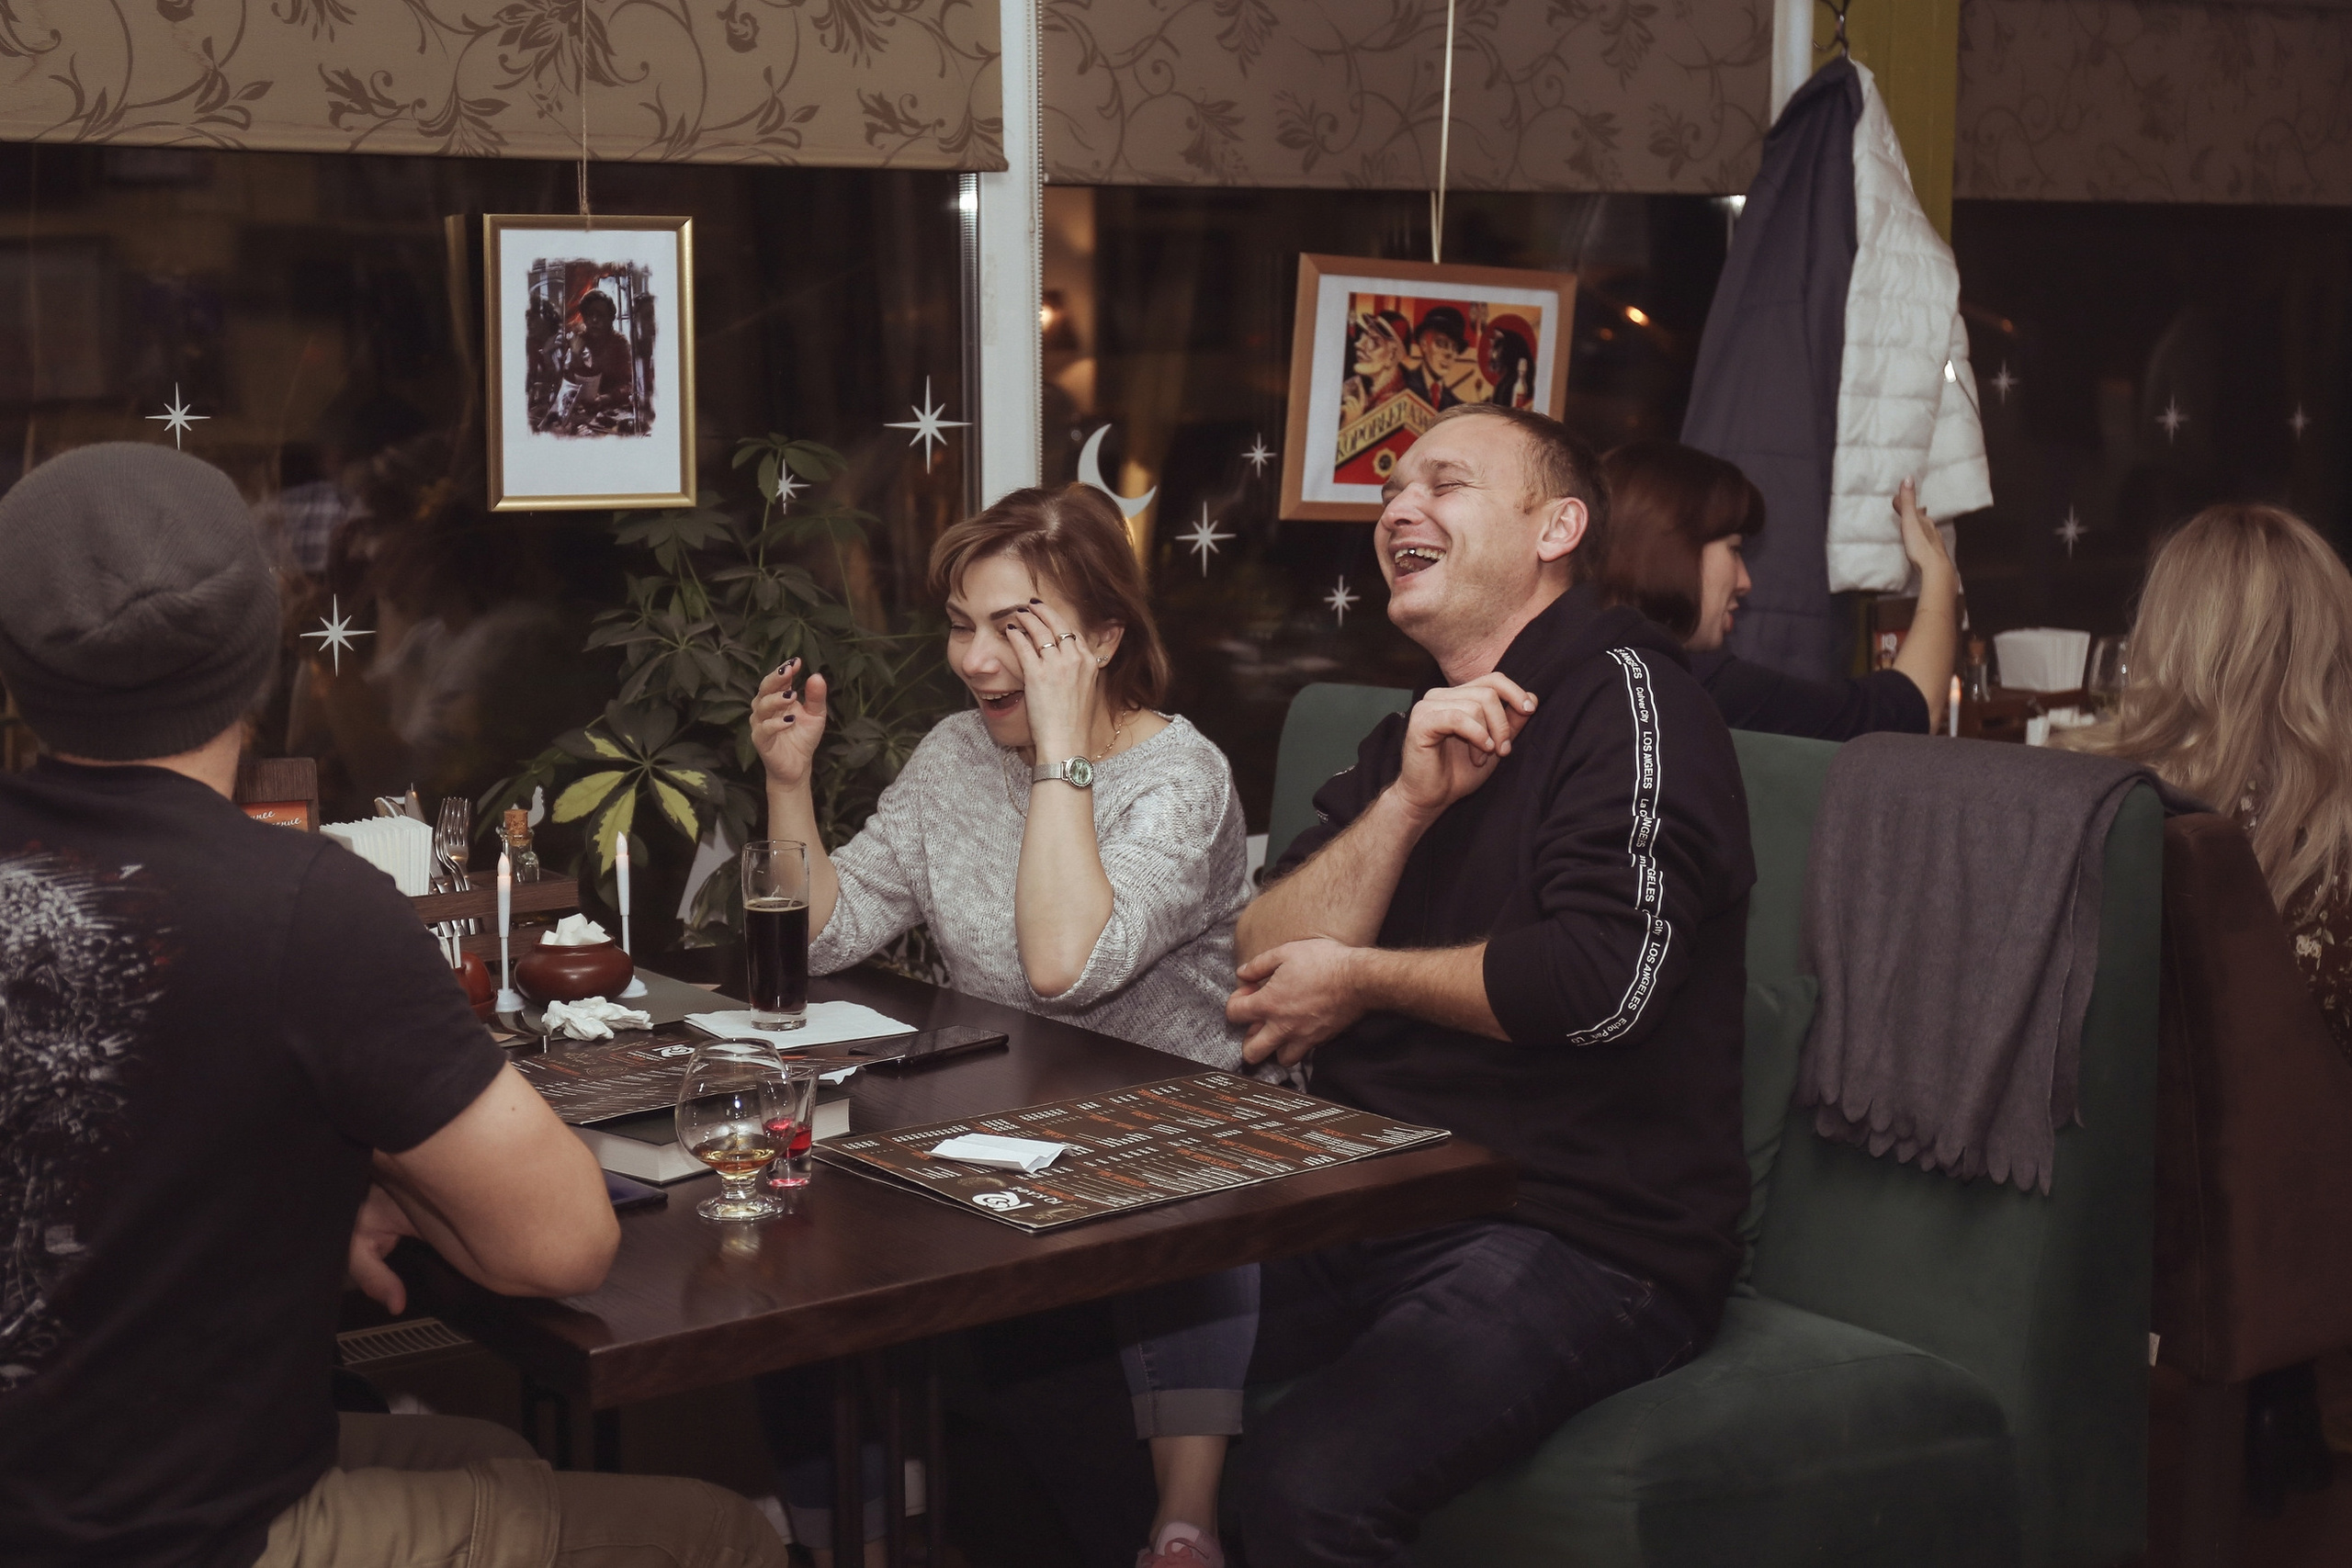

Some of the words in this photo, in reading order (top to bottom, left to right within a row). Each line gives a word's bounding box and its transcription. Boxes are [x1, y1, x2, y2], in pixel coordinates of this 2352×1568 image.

[1635, 686, 1645, 710] Culver
[1640, 709, 1649, 723] City
[1643, 730, 1653, 752] LOS
[1643, 752, 1654, 790] ANGELES
[1646, 942, 1661, 964] LOS
[1627, 963, 1652, 1010] ANGELES
[1607, 1017, 1627, 1032] Echo
